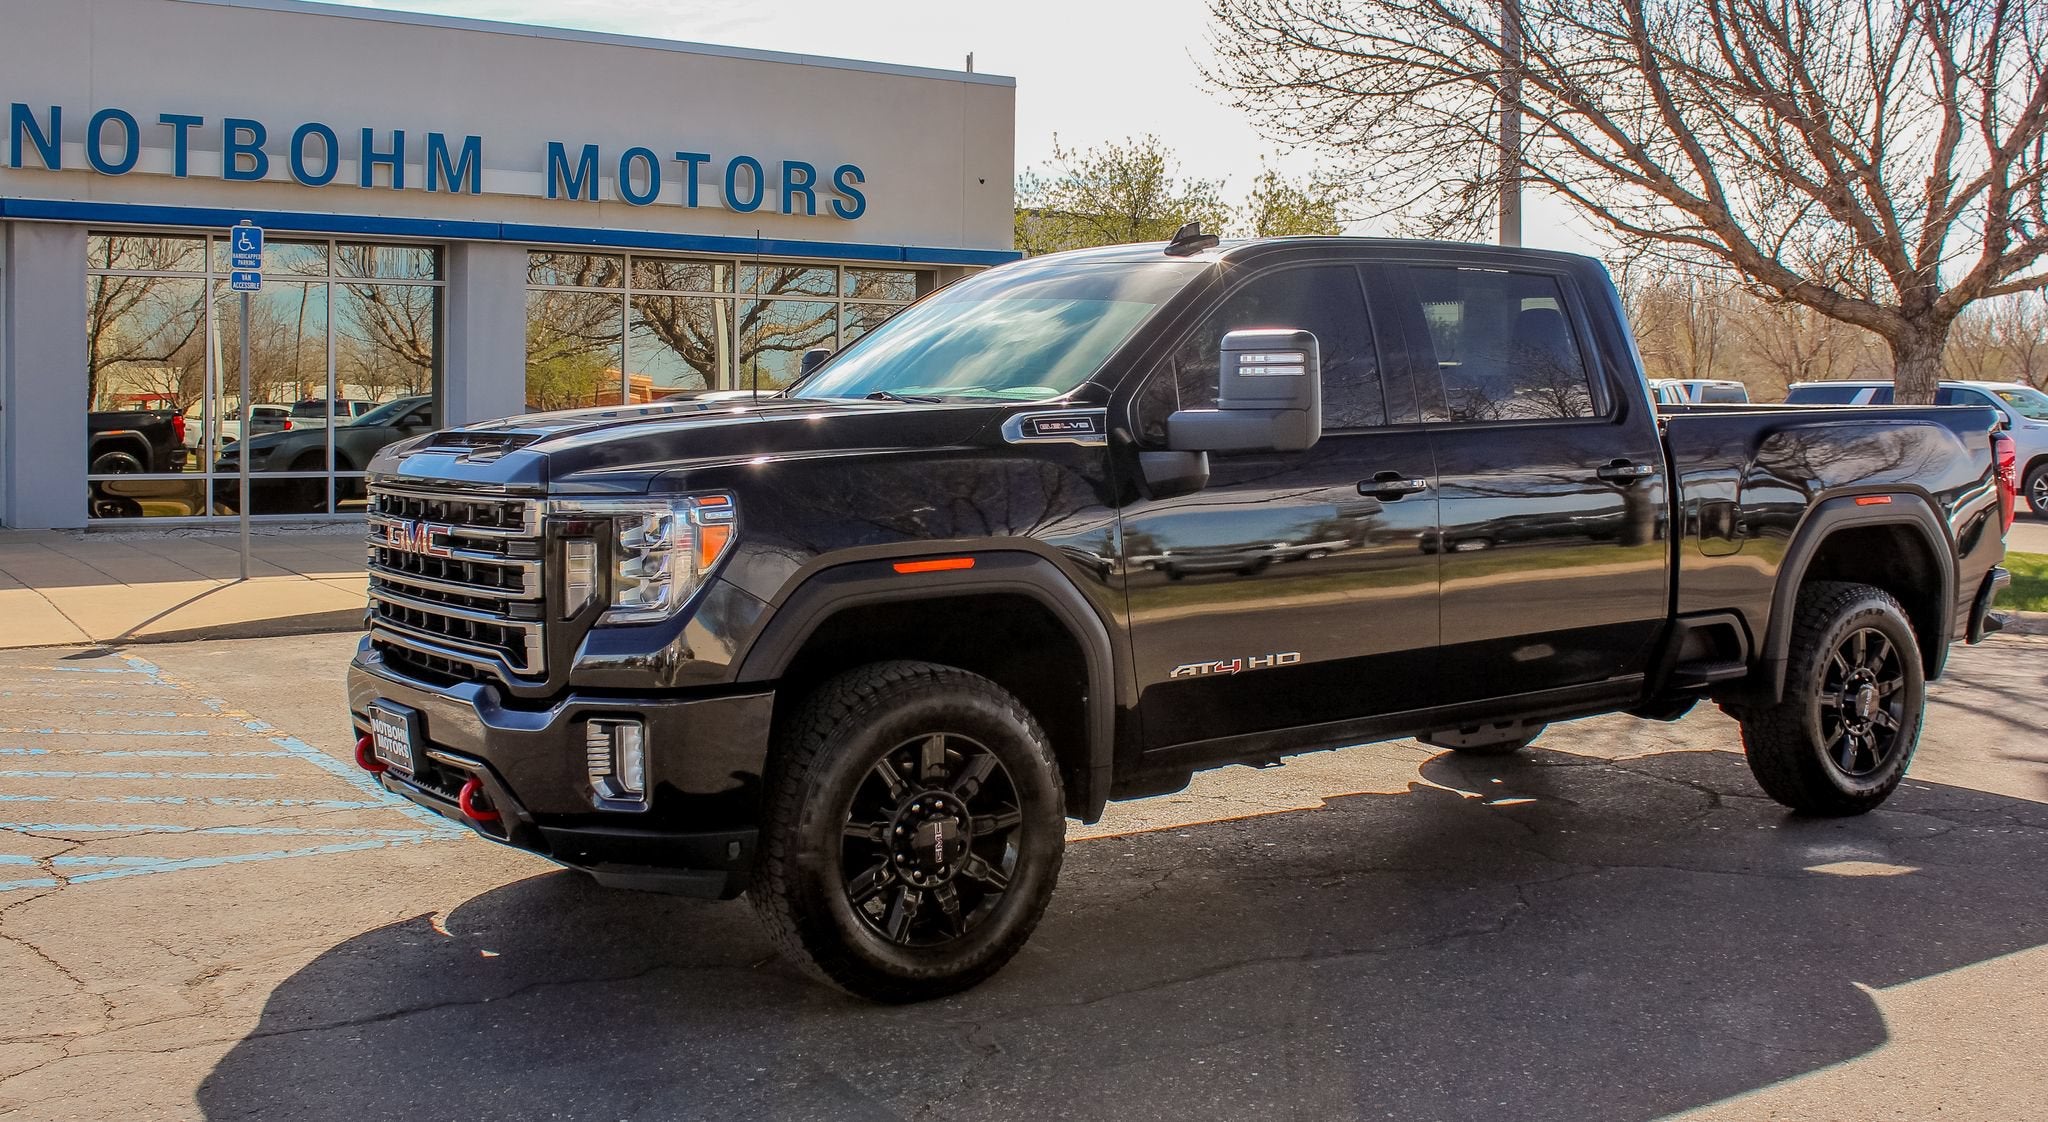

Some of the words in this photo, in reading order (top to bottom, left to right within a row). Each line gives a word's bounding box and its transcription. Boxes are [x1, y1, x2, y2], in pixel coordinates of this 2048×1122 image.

[9, 101, 483, 196] NOTBOHM
[544, 141, 868, 221] MOTORS
[233, 281, 260, 290] ACCESSIBLE
[241, 273, 252, 281] VAN
[387, 518, 453, 559] GMC
[1169, 658, 1242, 676] AT4
[1248, 651, 1301, 669] HD
[377, 734, 410, 759] MOTORS
[934, 822, 943, 863] GMC
